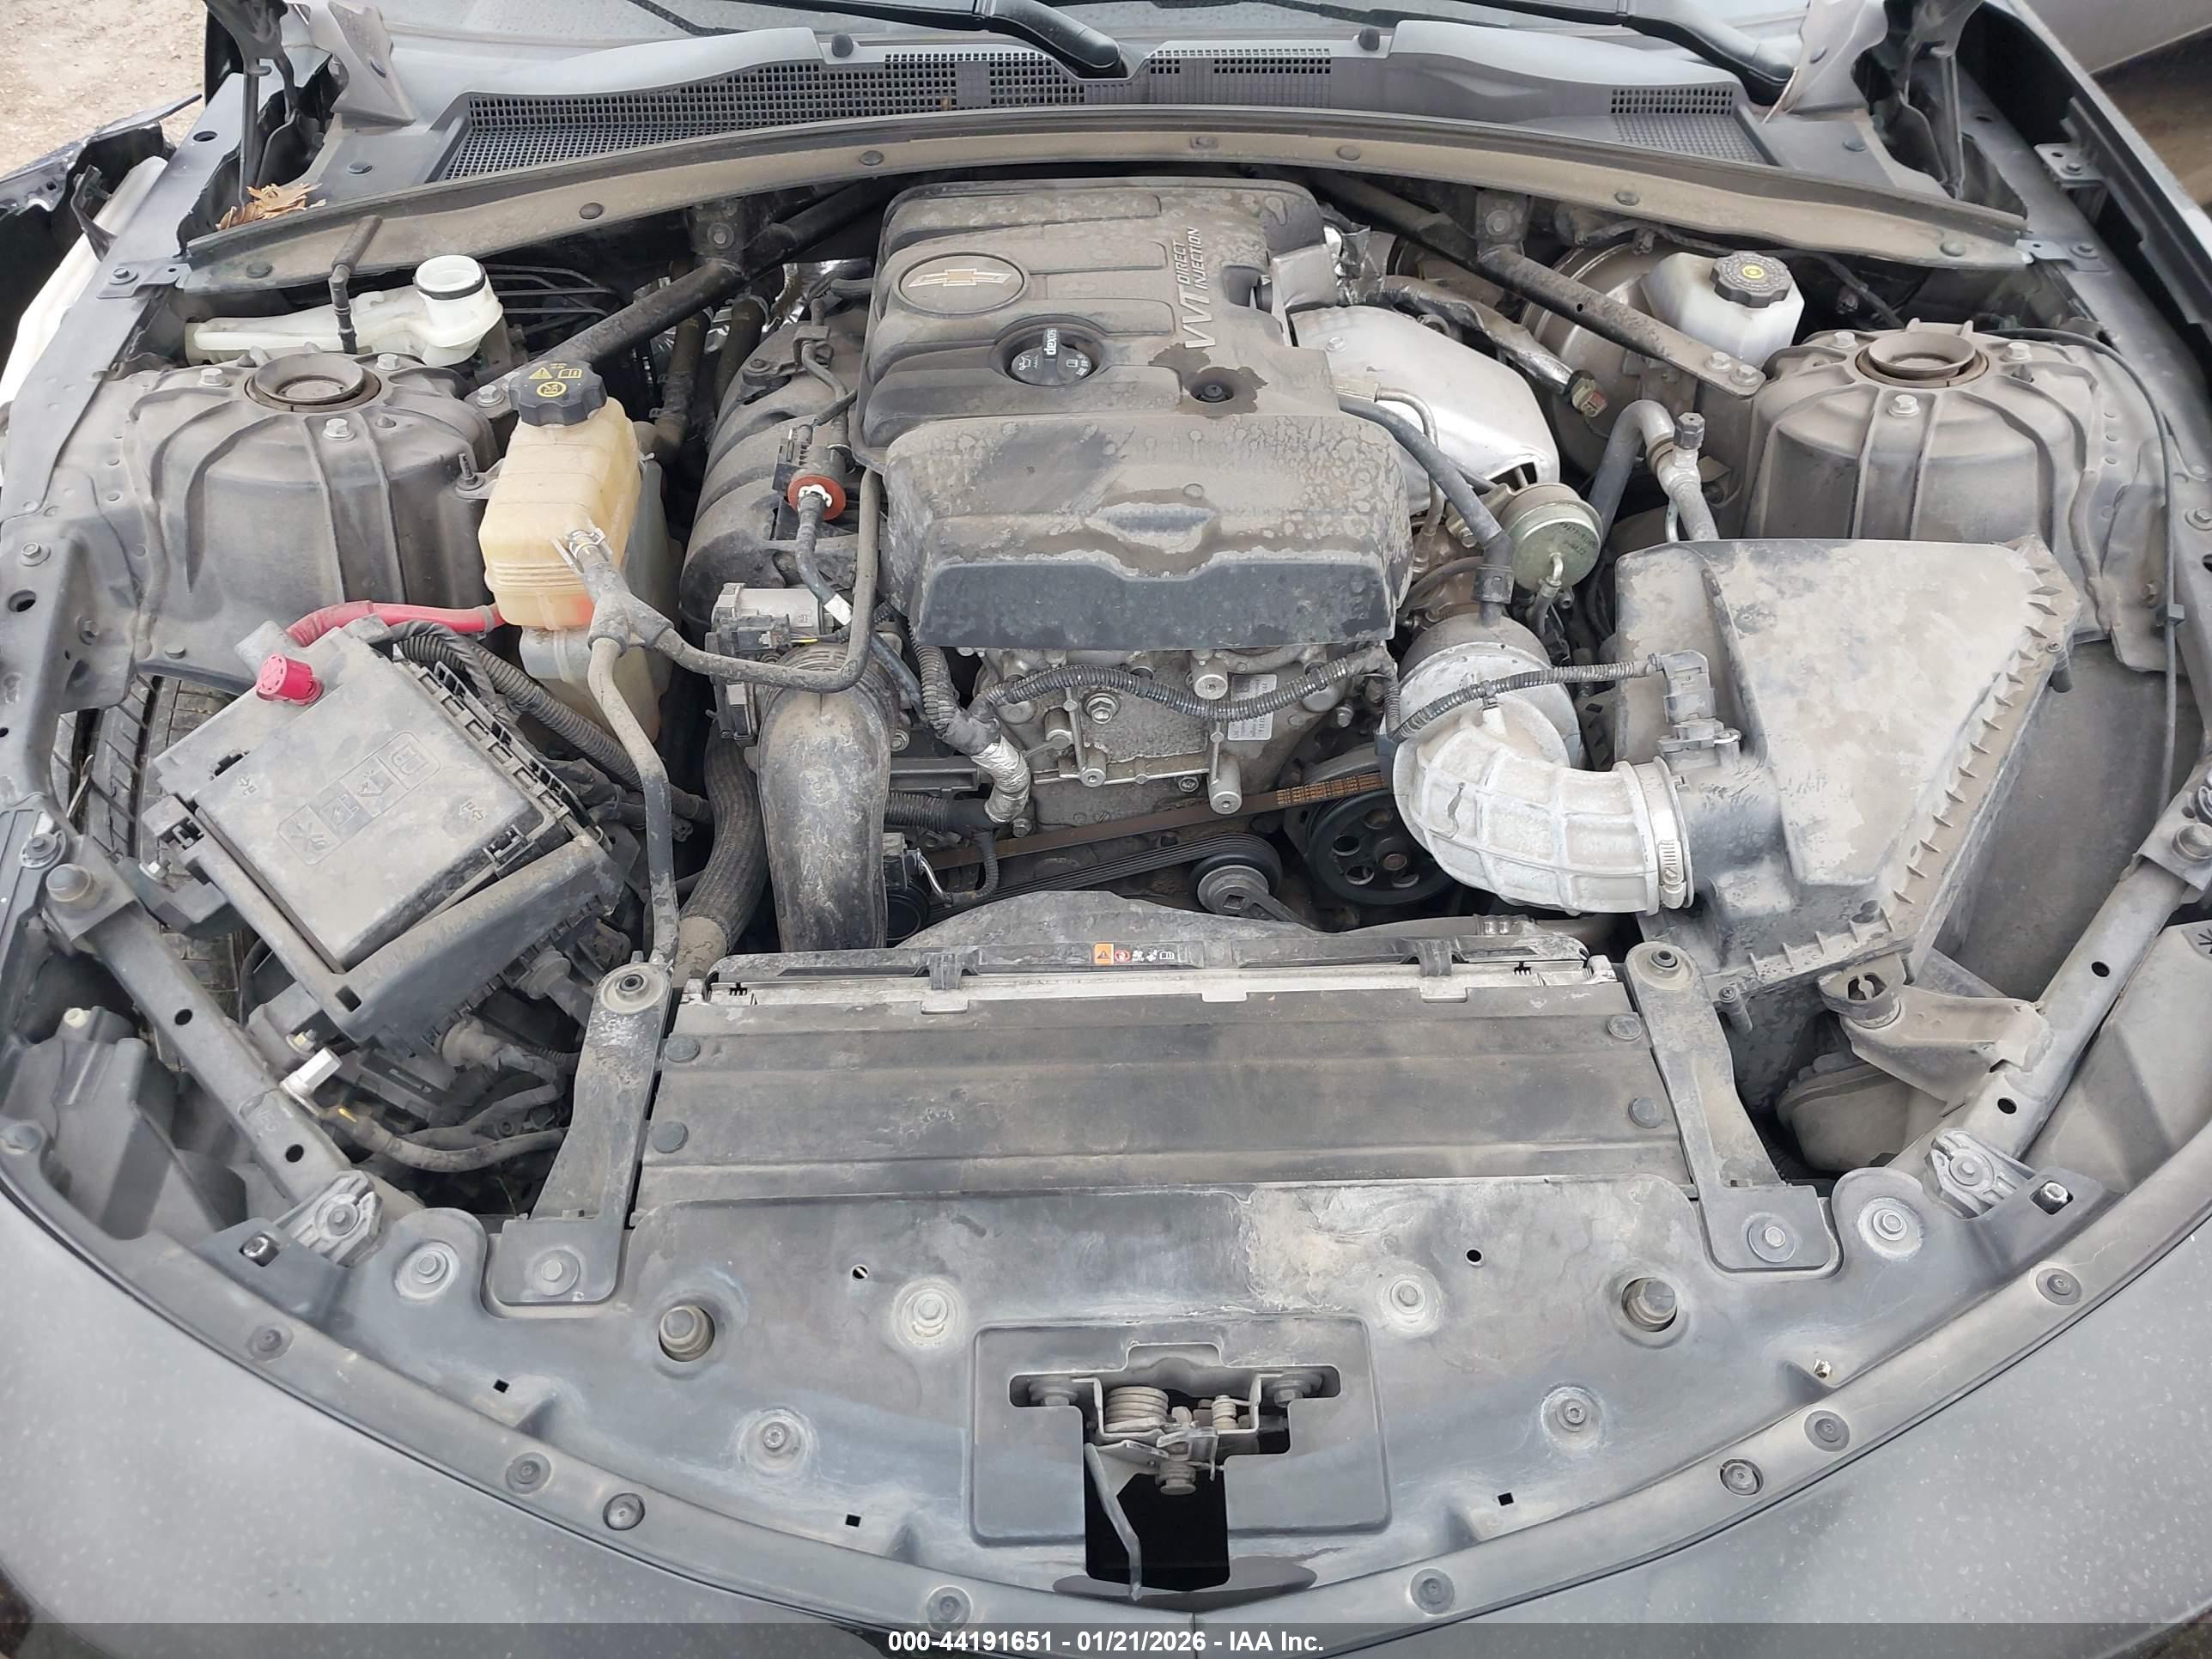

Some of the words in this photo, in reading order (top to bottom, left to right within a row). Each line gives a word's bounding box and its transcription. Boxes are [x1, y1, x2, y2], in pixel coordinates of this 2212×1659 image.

[1173, 239, 1191, 285] DIRECT
[1187, 226, 1209, 290] INJECTION
[1043, 328, 1058, 356] dexos
[1178, 283, 1216, 349] VVT
